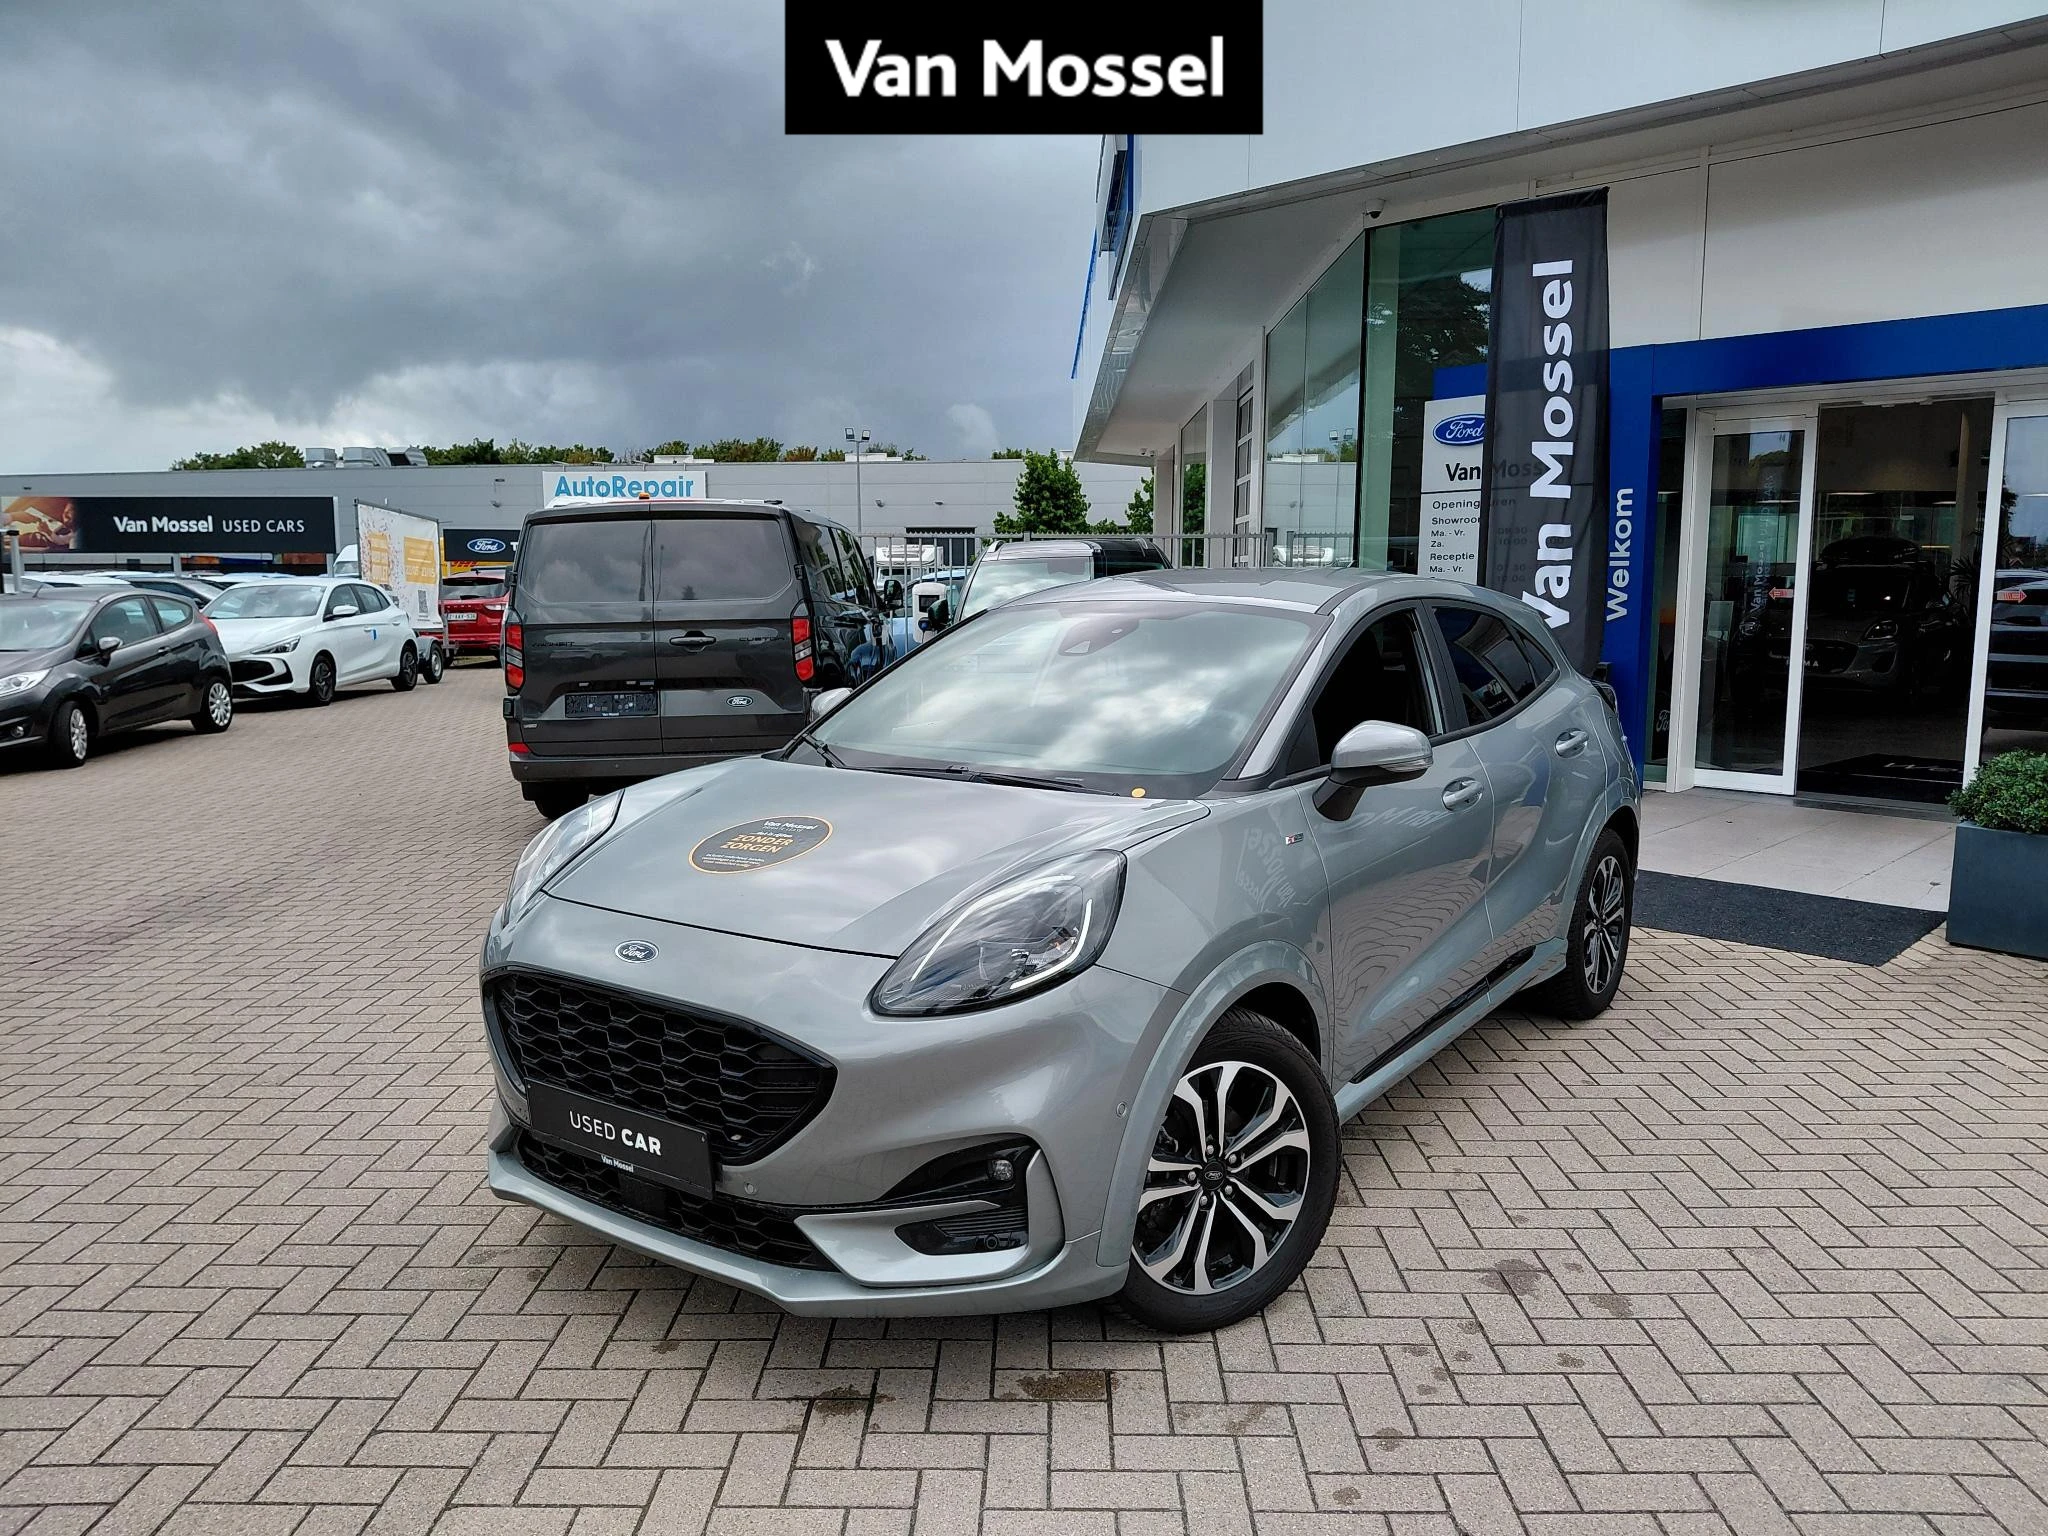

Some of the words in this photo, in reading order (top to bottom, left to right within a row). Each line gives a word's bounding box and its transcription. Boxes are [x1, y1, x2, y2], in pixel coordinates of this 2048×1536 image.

[1529, 259, 1574, 499] Mossel
[1444, 419, 1485, 439] Ford
[1445, 462, 1481, 482] Van
[554, 475, 694, 498] AutoRepair
[113, 516, 148, 533] Van
[151, 515, 214, 533] Mossel
[222, 519, 261, 533] USED
[266, 519, 305, 533] CARS
[1431, 516, 1481, 526] Showroo
[1430, 529, 1447, 537] Ma.
[1453, 529, 1466, 537] Vr.
[472, 539, 499, 551] Ford
[1430, 540, 1445, 548] Za.
[1429, 552, 1475, 561] Receptie
[1606, 487, 1634, 622] Welkom
[1429, 565, 1446, 573] Ma.
[1452, 565, 1464, 573] Vr.
[1521, 522, 1573, 629] Van
[720, 841, 783, 854] ZORGEN
[731, 834, 794, 846] ZONDER
[621, 943, 651, 960] Ford
[568, 1110, 616, 1142] USED
[621, 1128, 663, 1156] CAR
[601, 1154, 613, 1167] Van
[613, 1157, 634, 1174] Mossel
